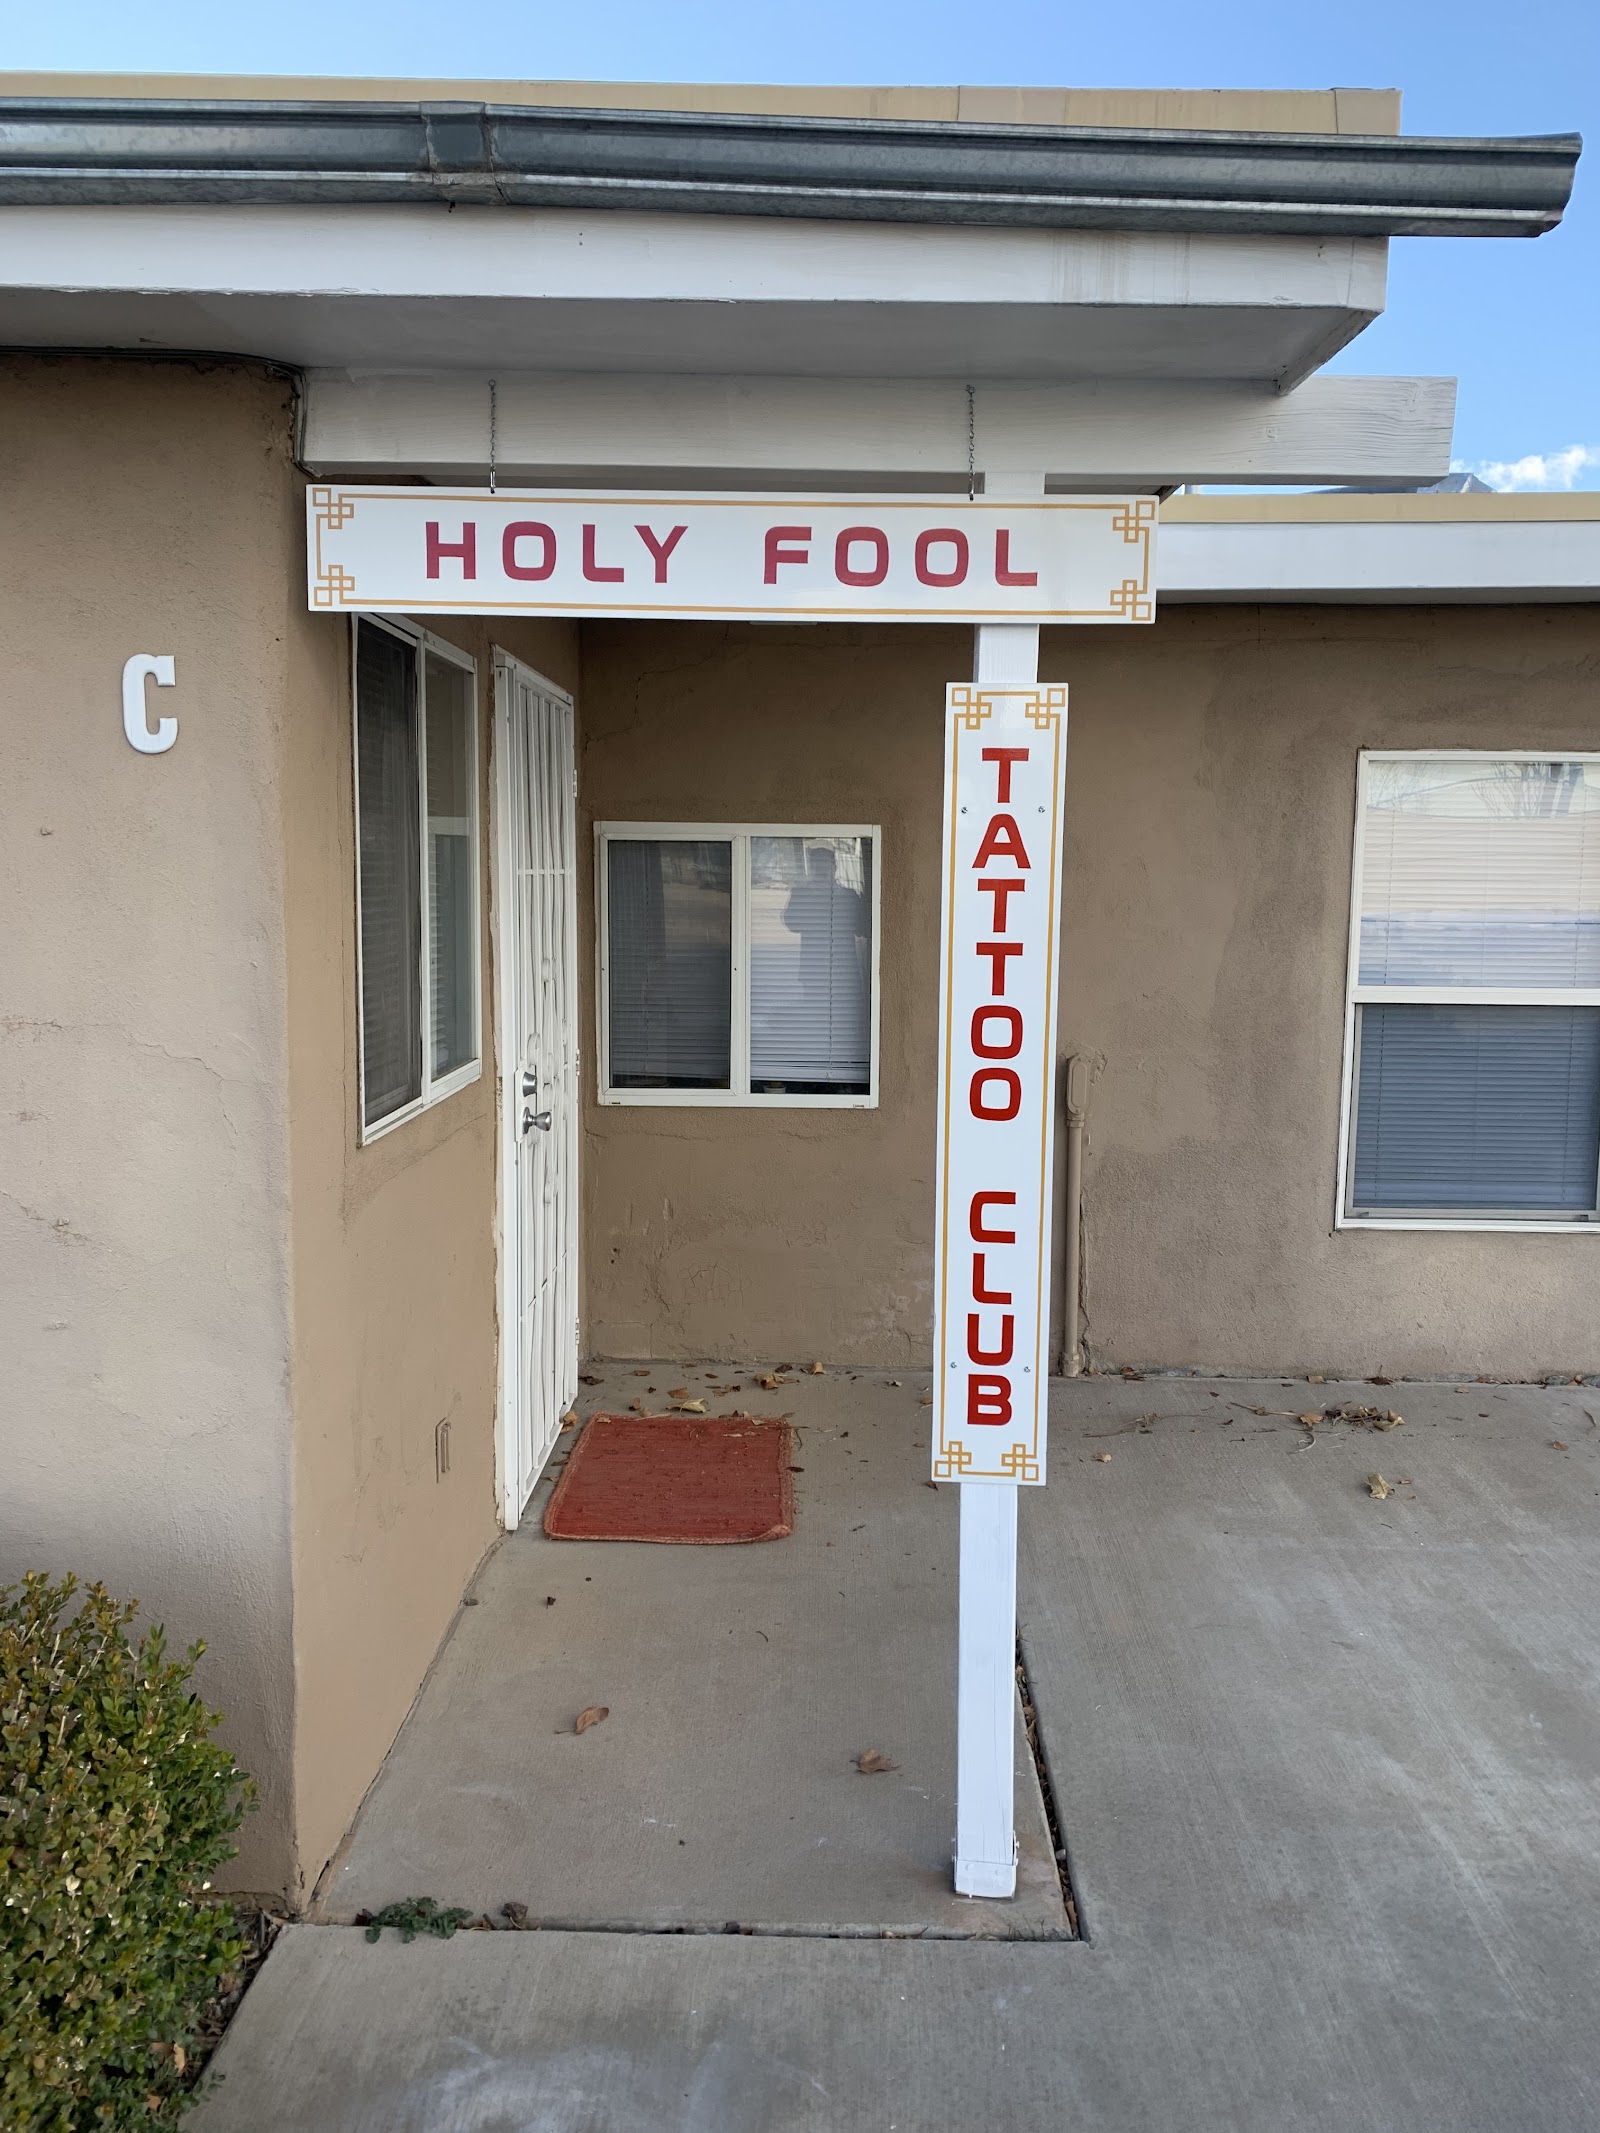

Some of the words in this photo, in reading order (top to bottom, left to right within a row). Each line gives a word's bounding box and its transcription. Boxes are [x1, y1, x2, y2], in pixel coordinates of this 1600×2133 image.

[425, 521, 688, 584] HOLY
[763, 526, 1038, 587] FOOL
[122, 653, 178, 754] C
[969, 747, 1031, 1122] TATTOO
[967, 1191, 1017, 1426] CLUB
